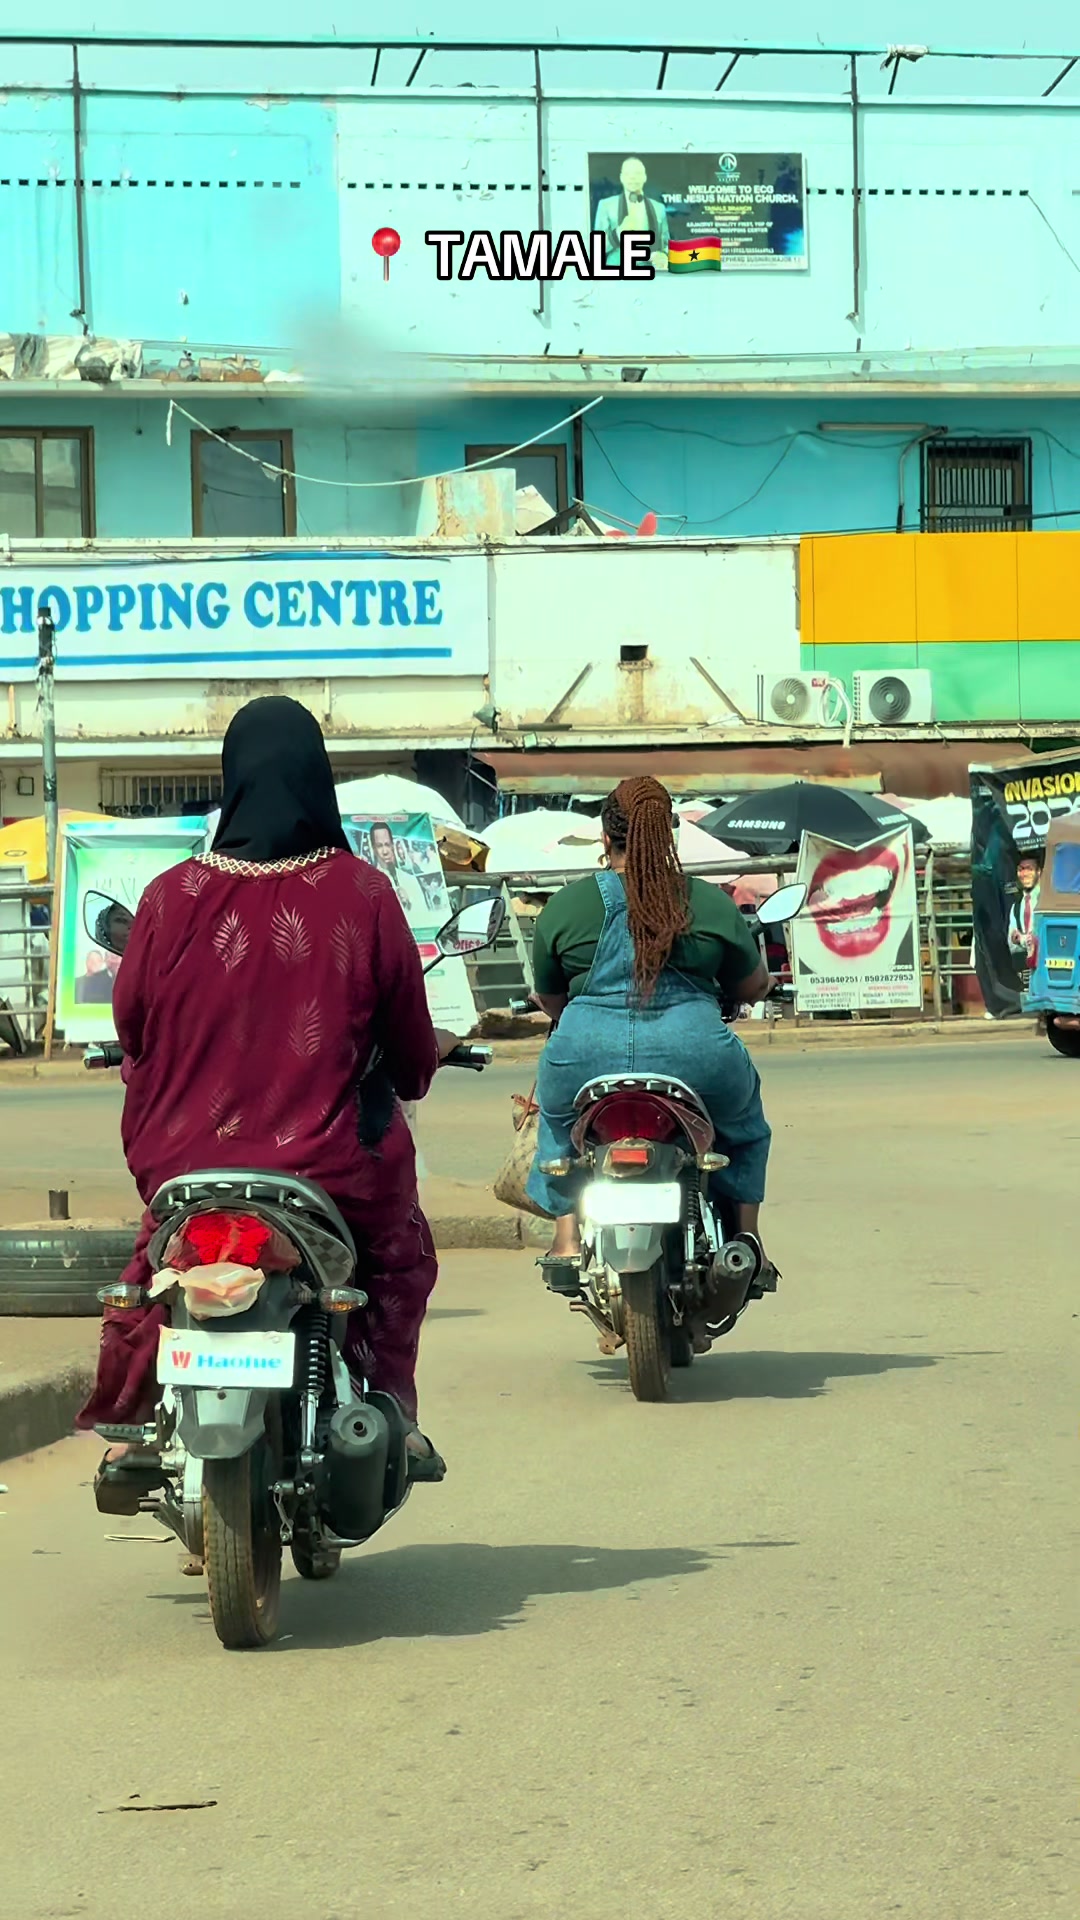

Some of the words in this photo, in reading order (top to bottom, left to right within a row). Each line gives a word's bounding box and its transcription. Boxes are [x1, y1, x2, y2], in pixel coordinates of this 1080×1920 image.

[688, 185, 737, 194] WELCOME
[739, 185, 752, 194] TO
[754, 185, 774, 194] ECG
[662, 194, 682, 203] THE
[684, 194, 715, 203] JESUS
[717, 194, 753, 203] NATION
[244, 580, 443, 629] CENTRE
[727, 819, 786, 830] SAMSUNG
